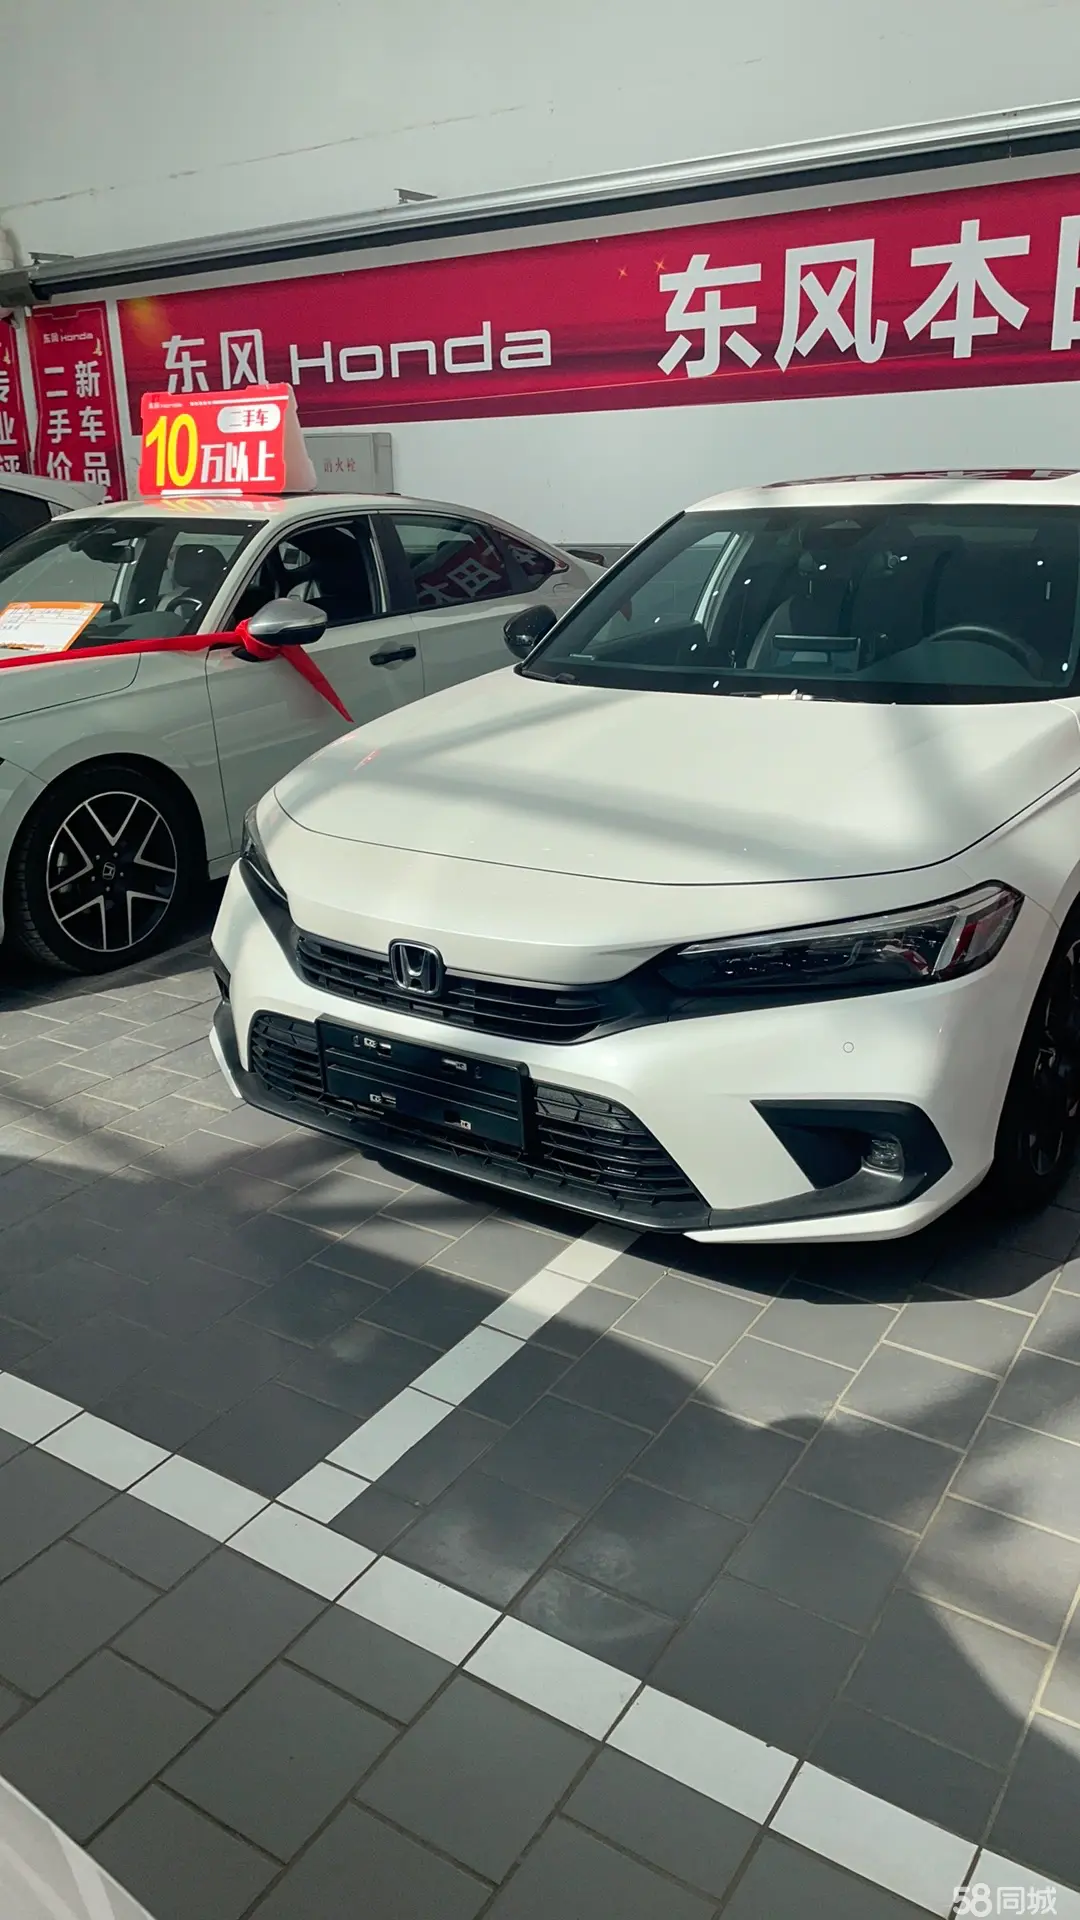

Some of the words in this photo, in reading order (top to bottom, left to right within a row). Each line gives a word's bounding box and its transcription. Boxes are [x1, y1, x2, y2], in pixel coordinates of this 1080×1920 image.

[657, 215, 1080, 378] 东风本
[161, 328, 269, 394] 东风
[289, 321, 552, 385] Honda
[74, 360, 113, 505] 新车品
[228, 408, 269, 428] 二手车
